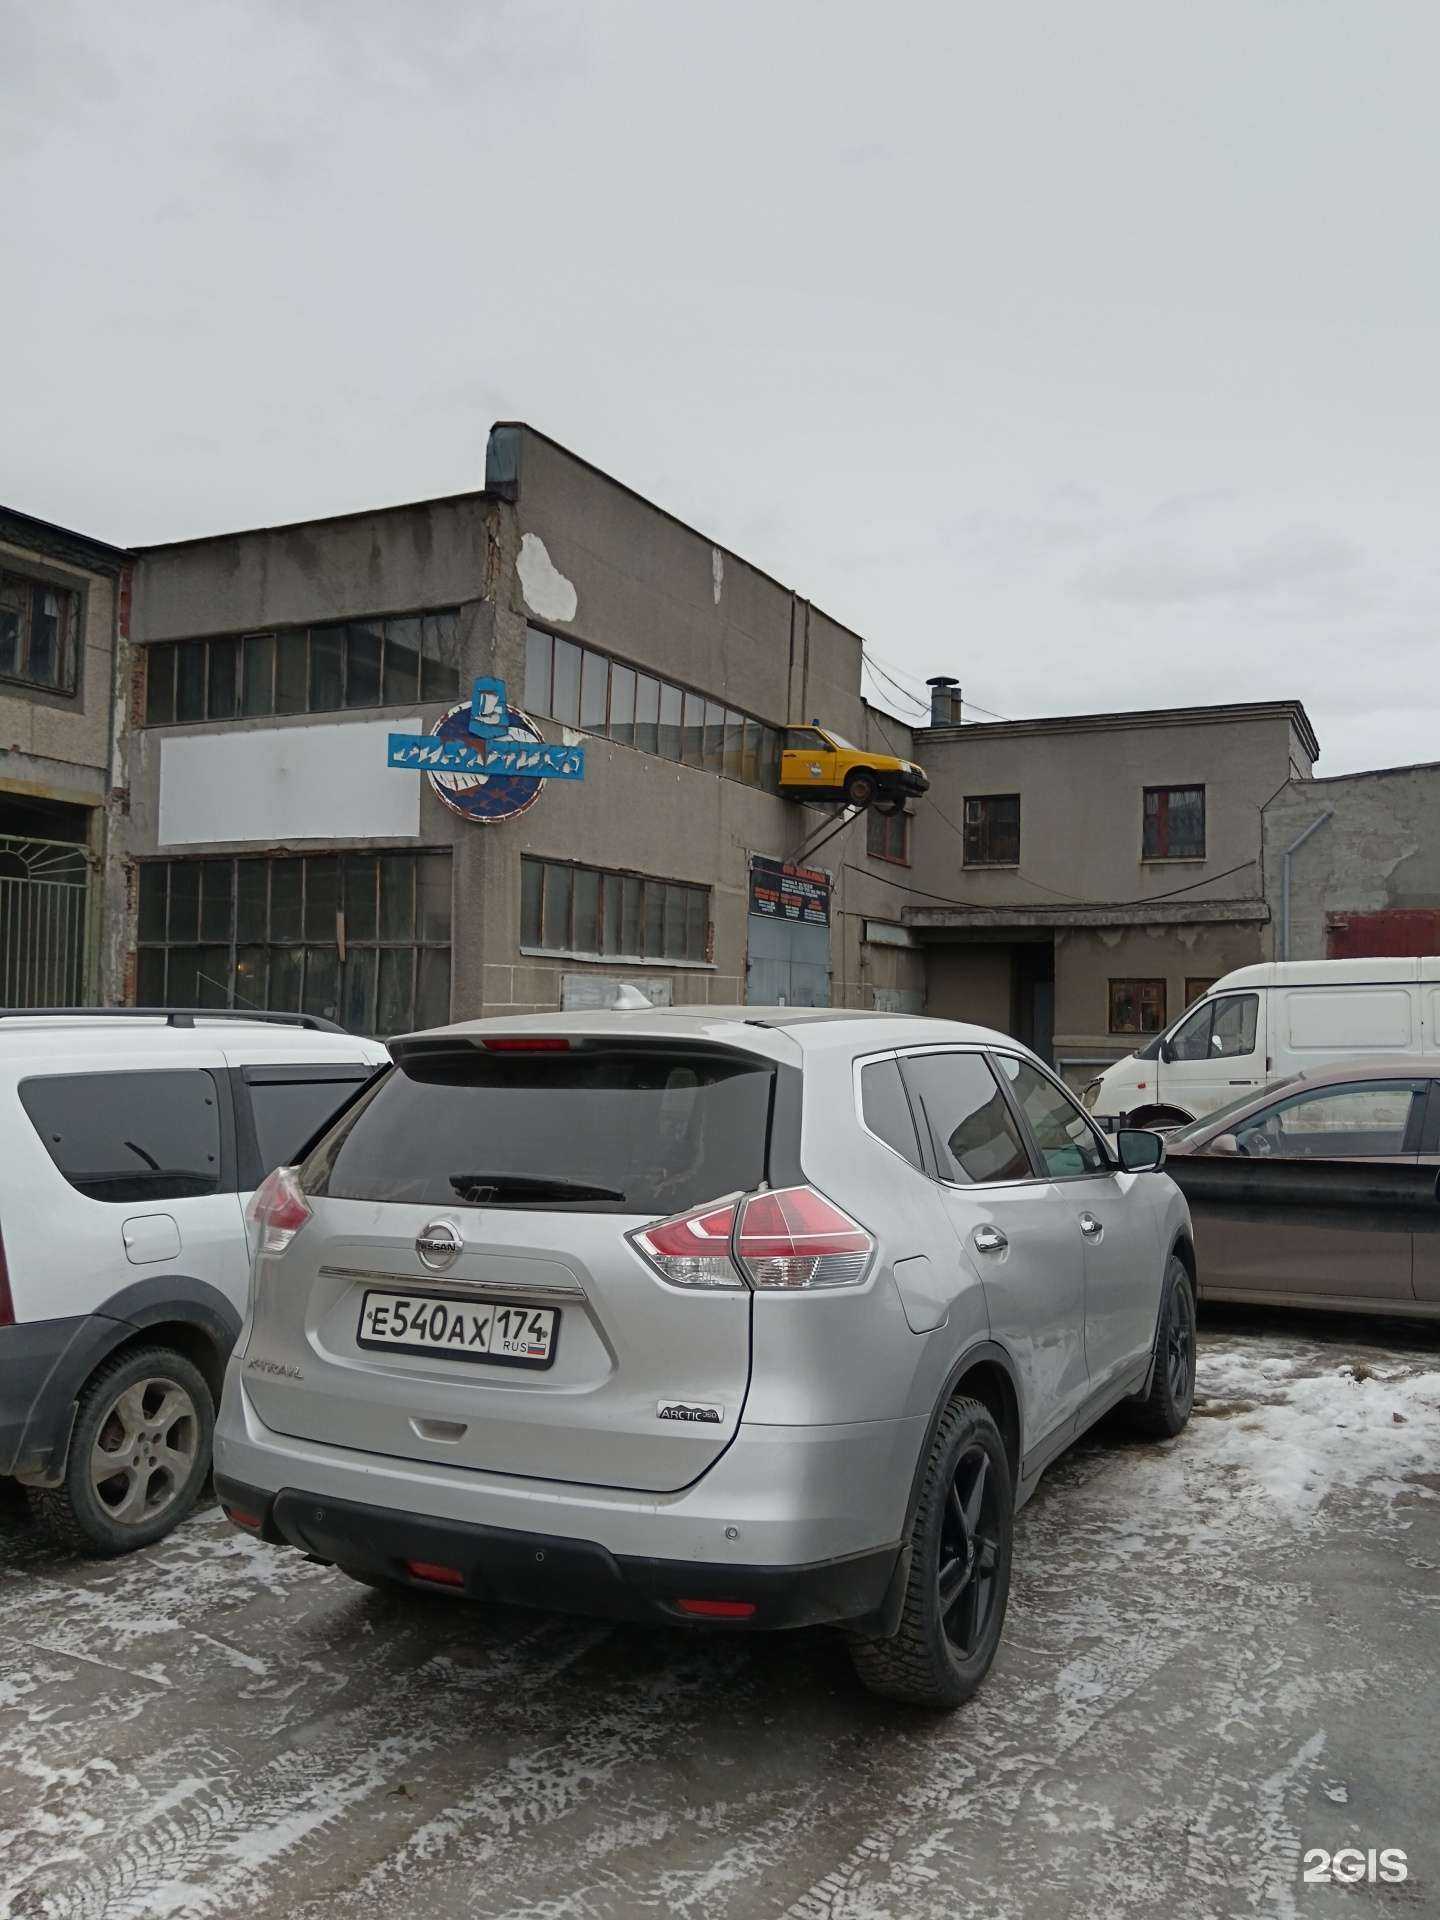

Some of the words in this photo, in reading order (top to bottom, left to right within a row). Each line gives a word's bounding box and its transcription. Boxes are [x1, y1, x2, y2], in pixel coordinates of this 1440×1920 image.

[417, 1240, 456, 1251] NISSAN
[497, 1310, 544, 1343] 174
[503, 1341, 527, 1353] RUS
[661, 1410, 702, 1421] ARCTIC
